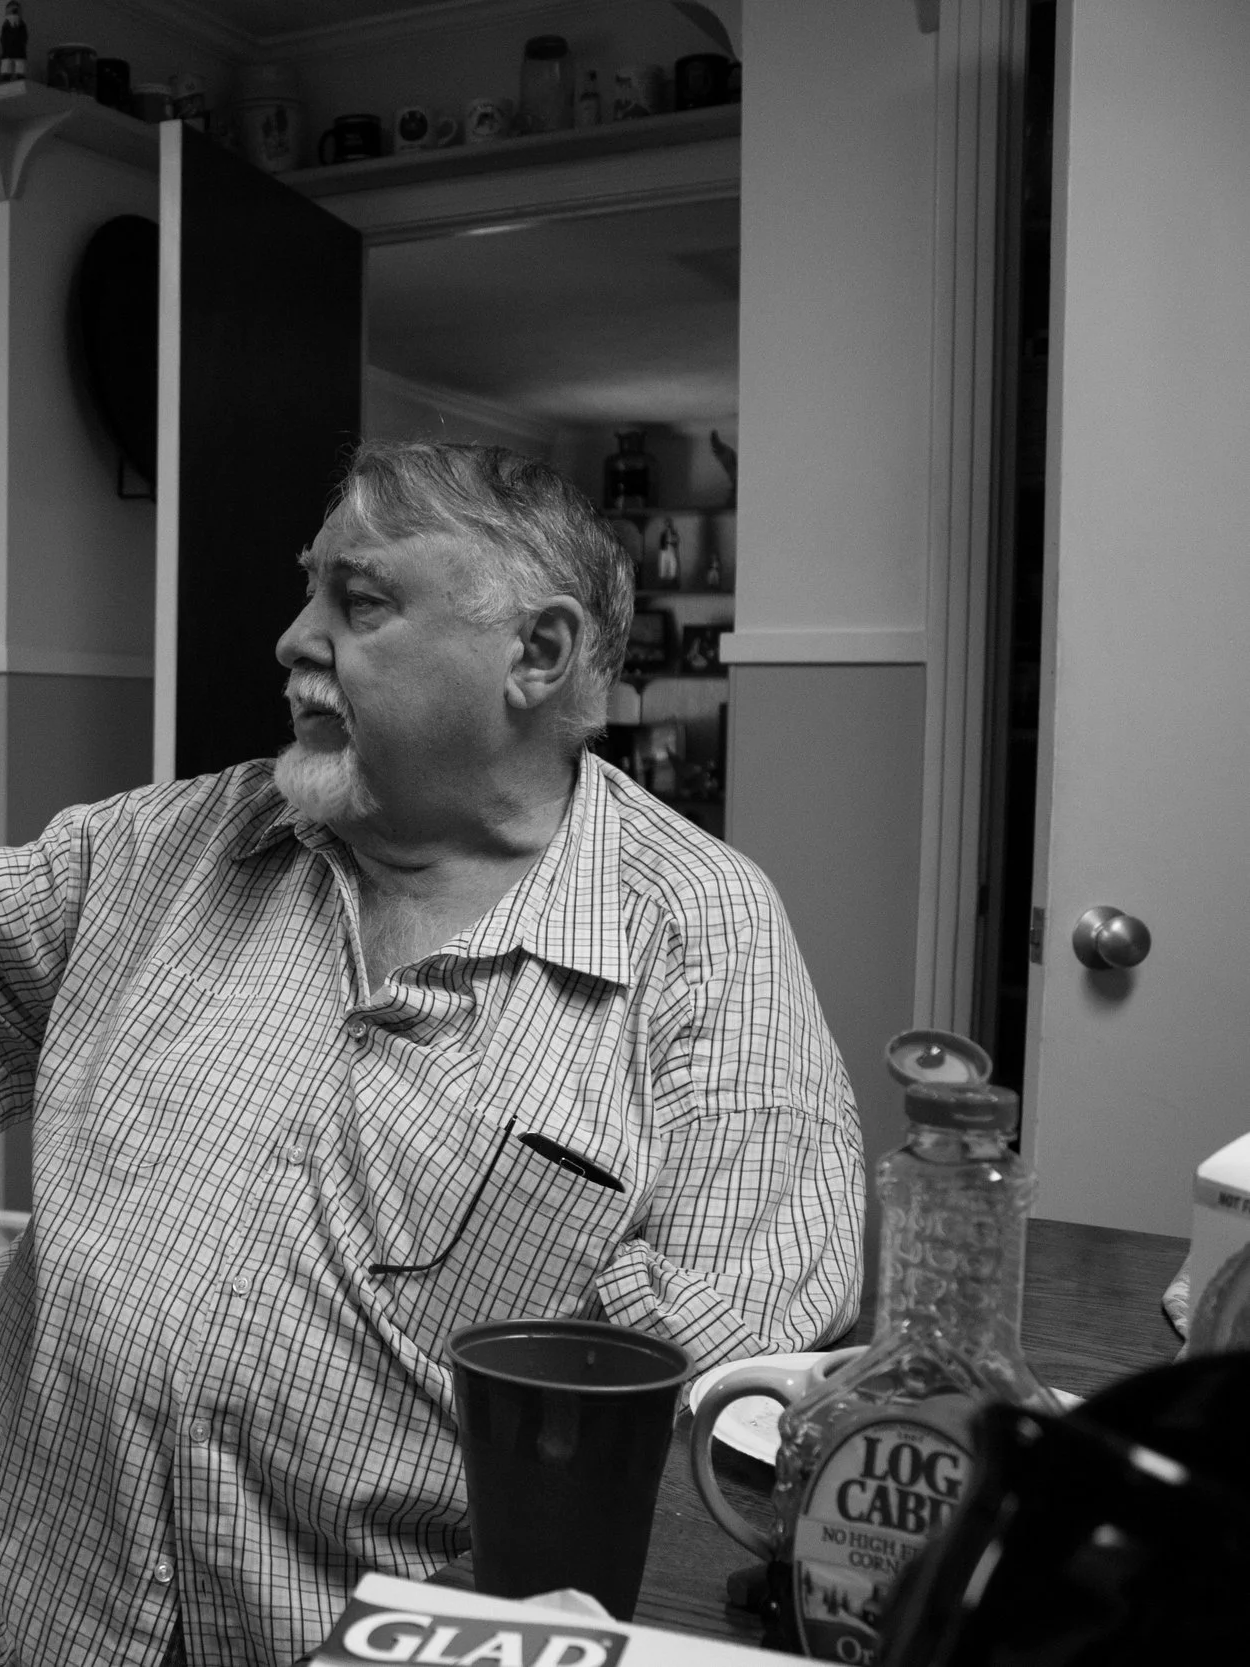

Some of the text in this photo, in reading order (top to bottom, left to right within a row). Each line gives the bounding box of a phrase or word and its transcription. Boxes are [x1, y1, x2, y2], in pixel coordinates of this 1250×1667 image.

[860, 1436, 963, 1500] LOG
[837, 1479, 954, 1535] CABI
[821, 1526, 848, 1546] NO
[850, 1532, 896, 1558] HIGH
[850, 1551, 900, 1574] CORN
[344, 1611, 608, 1667] GLAD
